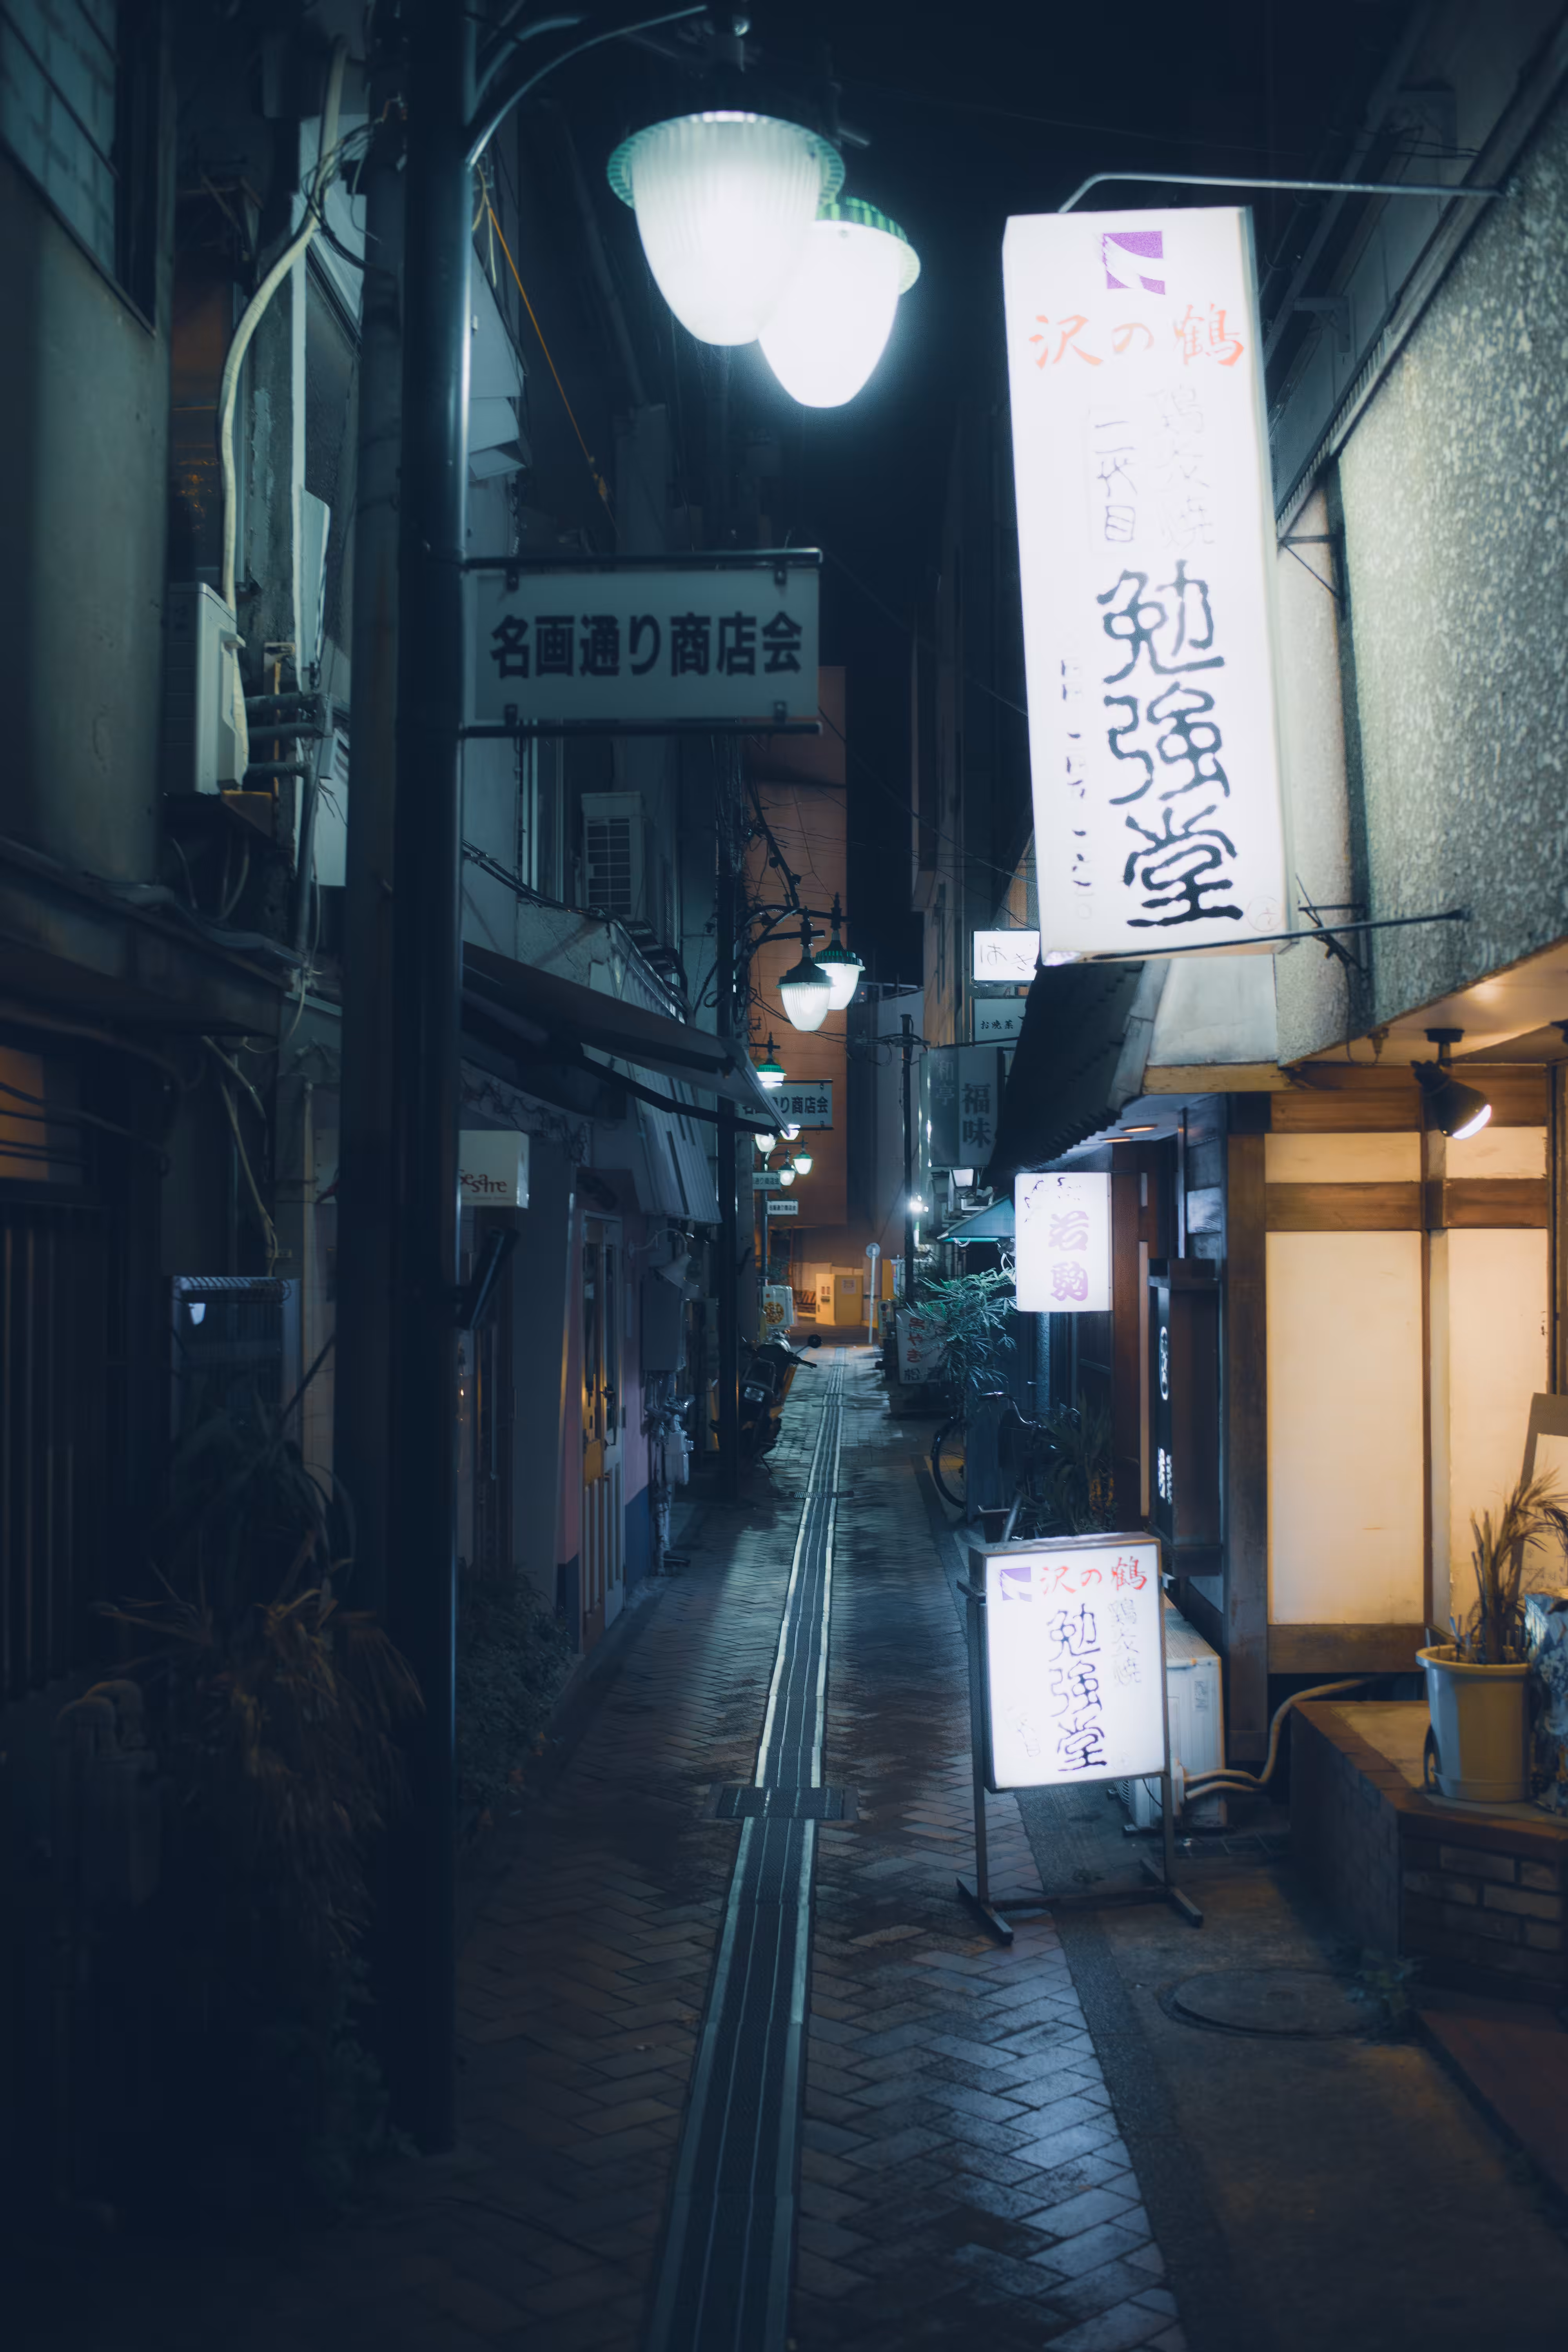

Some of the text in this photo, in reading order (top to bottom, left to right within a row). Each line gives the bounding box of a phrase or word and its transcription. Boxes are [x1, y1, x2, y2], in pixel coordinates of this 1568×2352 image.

[1029, 304, 1244, 369] 沢の鶴
[490, 612, 803, 679] 名画通り商店会
[1096, 559, 1243, 927] 勉強堂
[961, 1082, 992, 1148] 福味
[1040, 1556, 1147, 1595] 沢の鶴
[1046, 1603, 1107, 1771] 勉強堂
